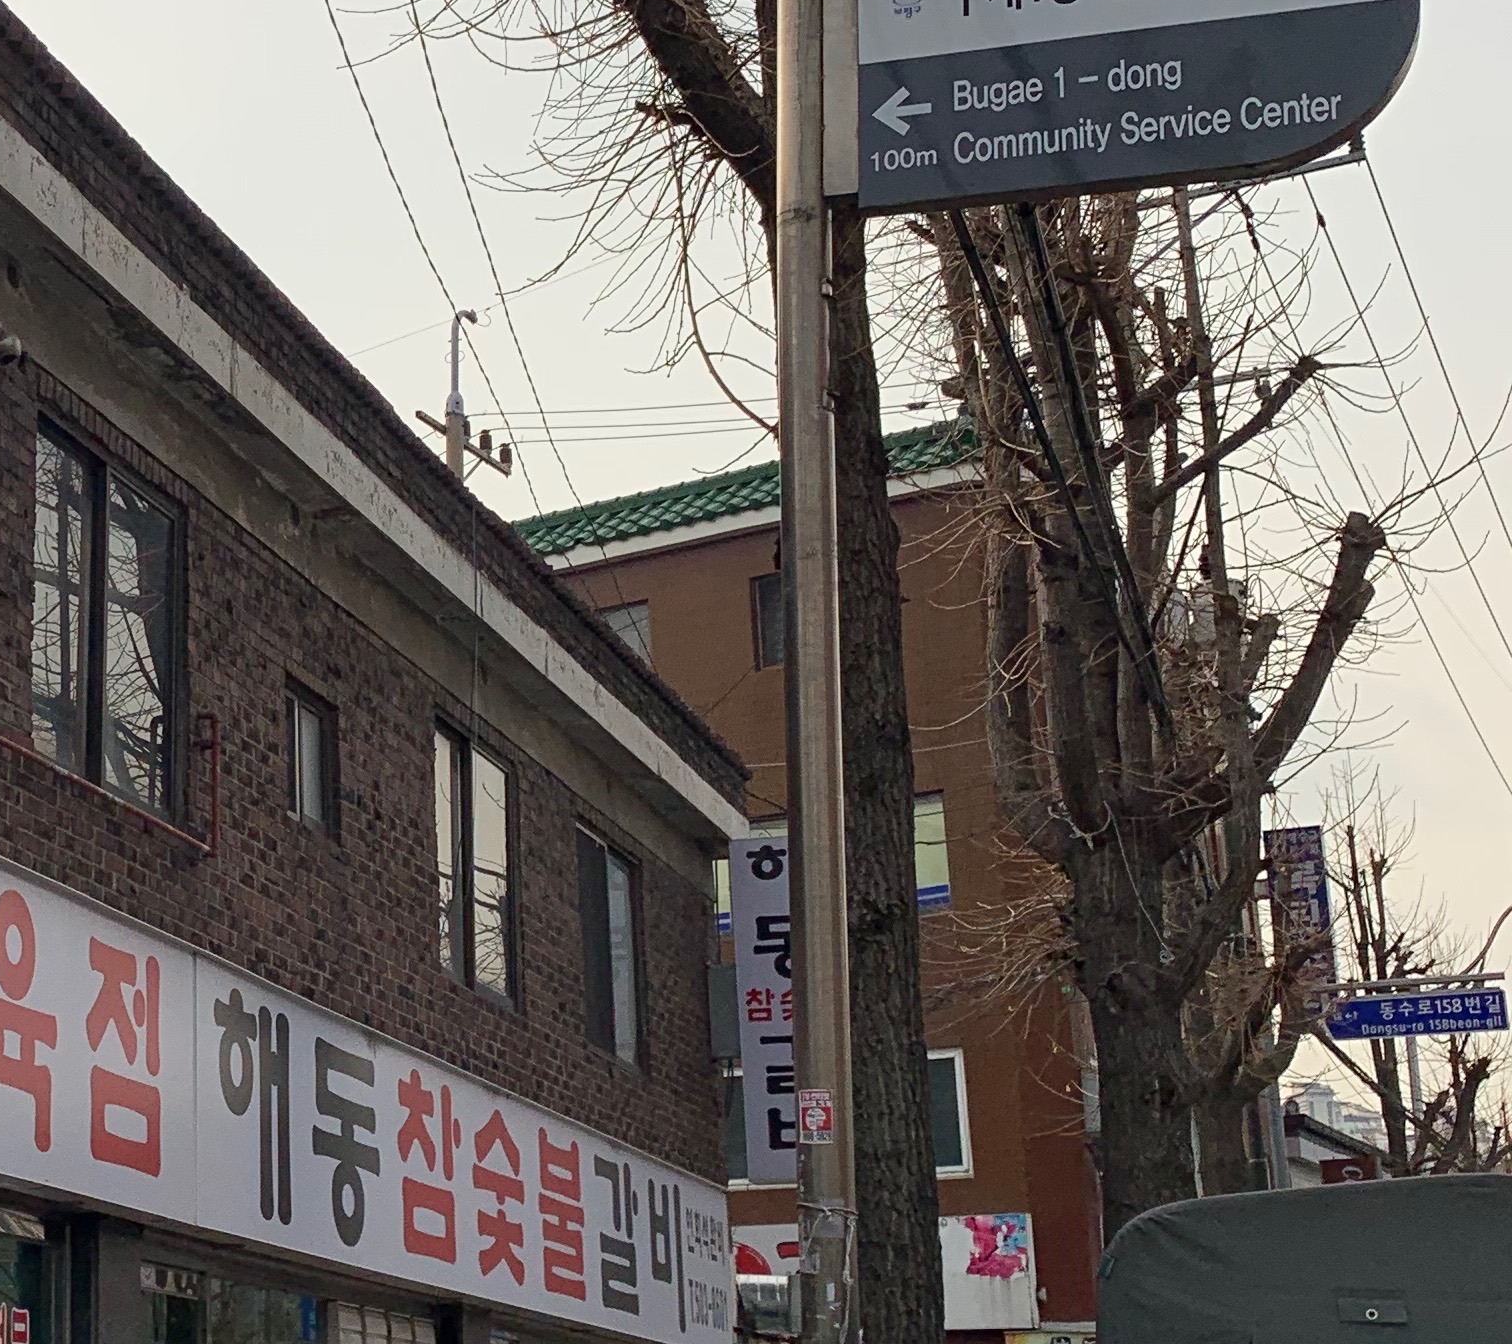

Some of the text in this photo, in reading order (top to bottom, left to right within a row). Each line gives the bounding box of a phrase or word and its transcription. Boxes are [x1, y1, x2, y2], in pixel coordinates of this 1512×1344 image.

[953, 78, 1043, 114] Bugae
[953, 93, 1343, 167] Community Service Center
[870, 147, 937, 172] 100m
[1380, 995, 1501, 1020] 동수로158번길
[1361, 1015, 1503, 1036] Dongsu-ro 158beon-gil
